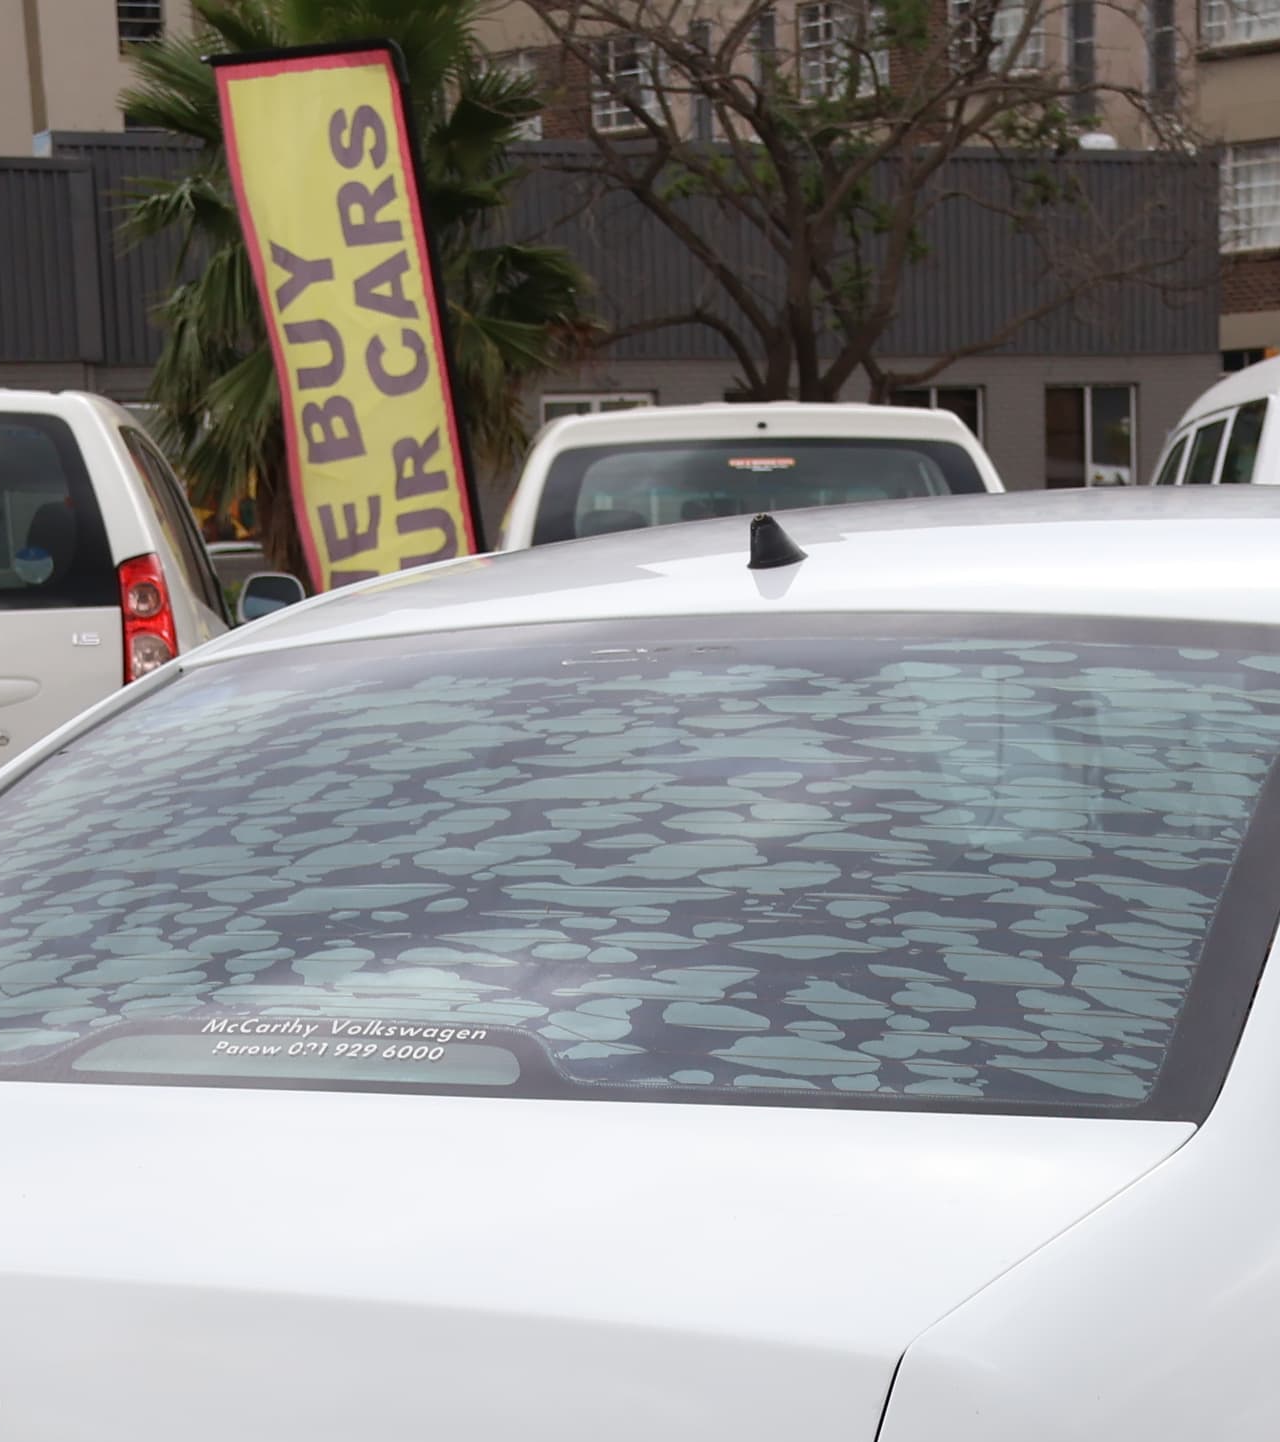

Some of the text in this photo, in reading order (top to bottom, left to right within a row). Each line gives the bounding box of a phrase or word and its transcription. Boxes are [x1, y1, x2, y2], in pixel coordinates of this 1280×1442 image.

[328, 104, 429, 396] CARS
[268, 239, 366, 464] BUY
[201, 1017, 487, 1043] McCarthy Volkswagen
[212, 1040, 281, 1055] Parow
[333, 1042, 377, 1057] 929
[382, 1045, 445, 1060] 6000
